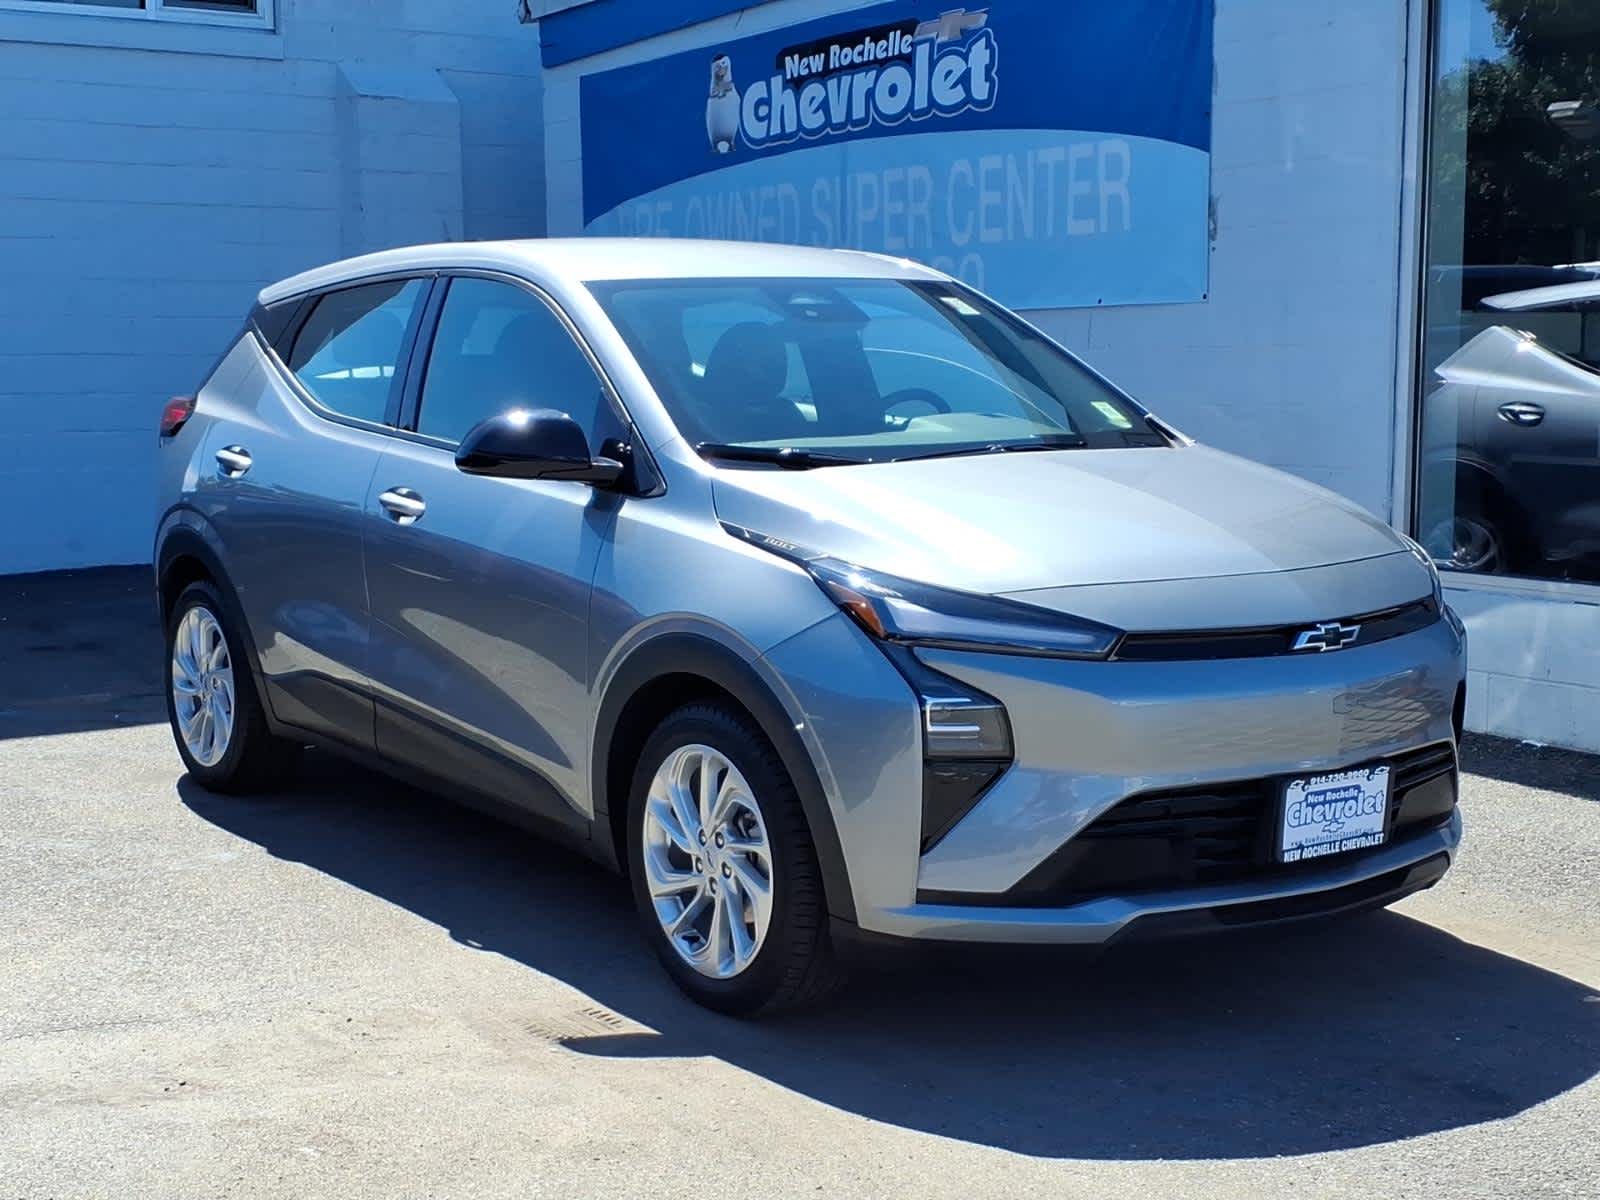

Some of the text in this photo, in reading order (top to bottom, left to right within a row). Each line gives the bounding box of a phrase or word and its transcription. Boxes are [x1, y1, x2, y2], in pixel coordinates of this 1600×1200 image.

[784, 30, 912, 79] New Rochelle
[741, 36, 992, 141] Chevrolet
[811, 165, 933, 249] SUPER
[947, 138, 1132, 247] CENTER
[1287, 791, 1385, 828] Chevrolet
[1307, 787, 1359, 804] New Rochelle
[1283, 845, 1301, 863] NEW
[1302, 840, 1341, 859] ROCHELLE
[1341, 832, 1385, 852] CHEVROLET
